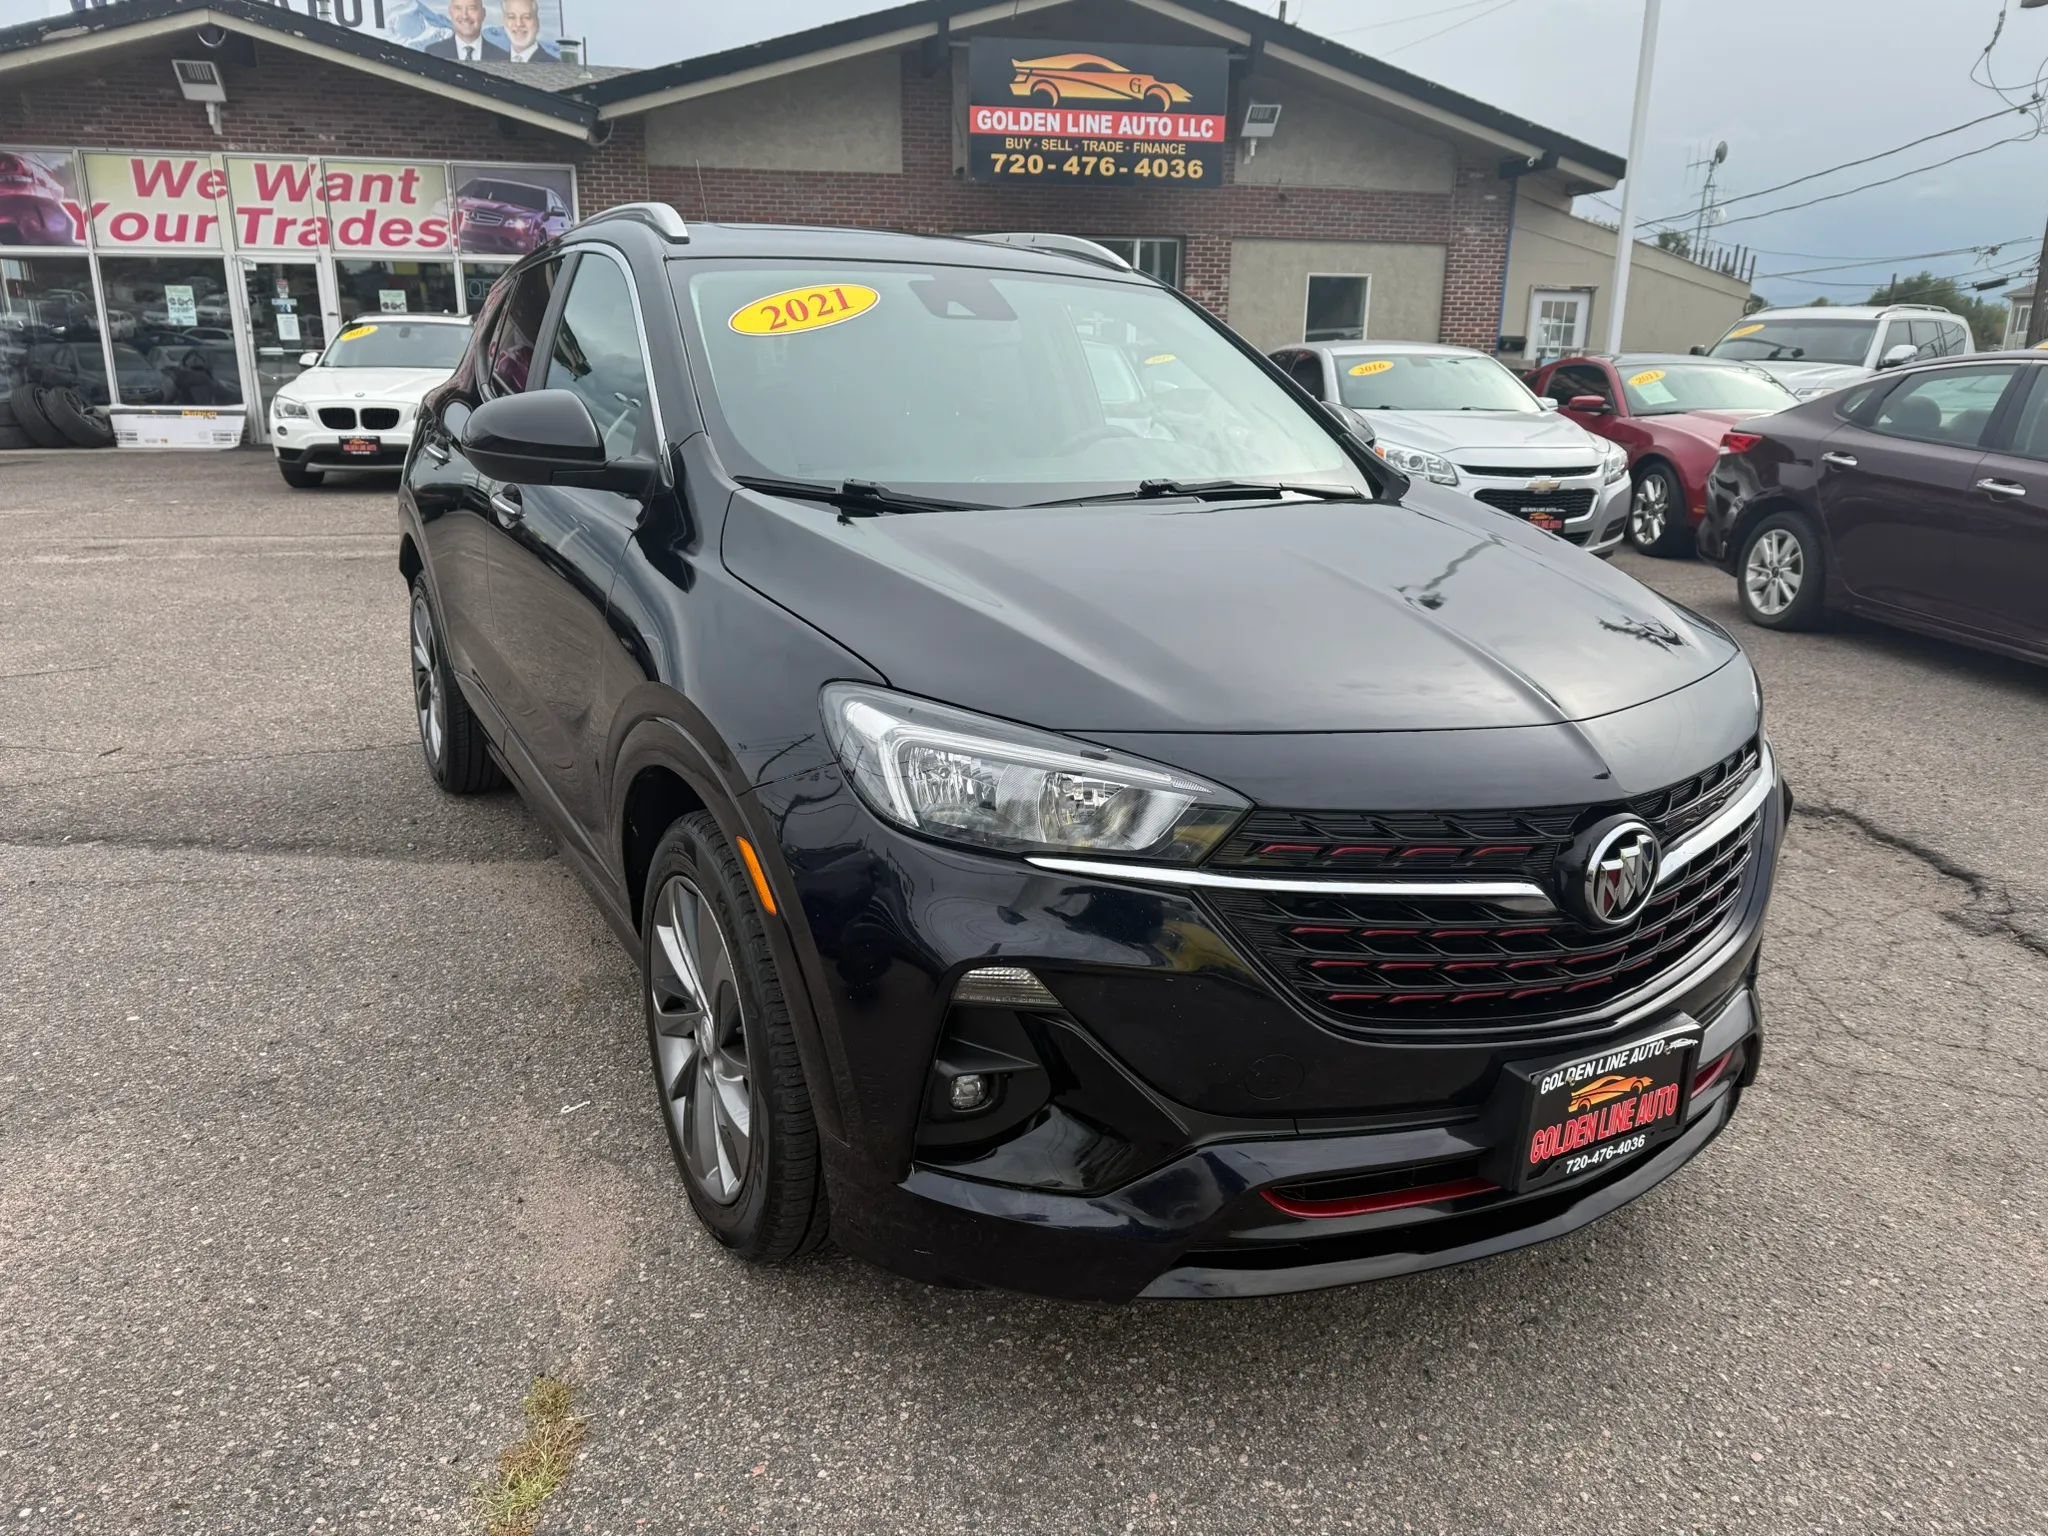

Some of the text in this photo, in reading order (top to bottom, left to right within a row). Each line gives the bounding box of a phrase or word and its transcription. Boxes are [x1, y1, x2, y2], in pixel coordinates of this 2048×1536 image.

[976, 109, 1214, 138] GOLDEN LINE AUTO LLC
[990, 153, 1204, 179] 720-476-4036
[1005, 138, 1187, 155] BUY SELL TRADE FINANCE
[130, 159, 420, 204] We Want
[62, 201, 220, 243] Your
[760, 288, 854, 331] 2021
[1540, 1039, 1666, 1094] GOLDEN LINE AUTO
[1530, 1083, 1679, 1164] GOLDEN LINE AUTO
[1565, 1134, 1646, 1174] 720-476-4036
